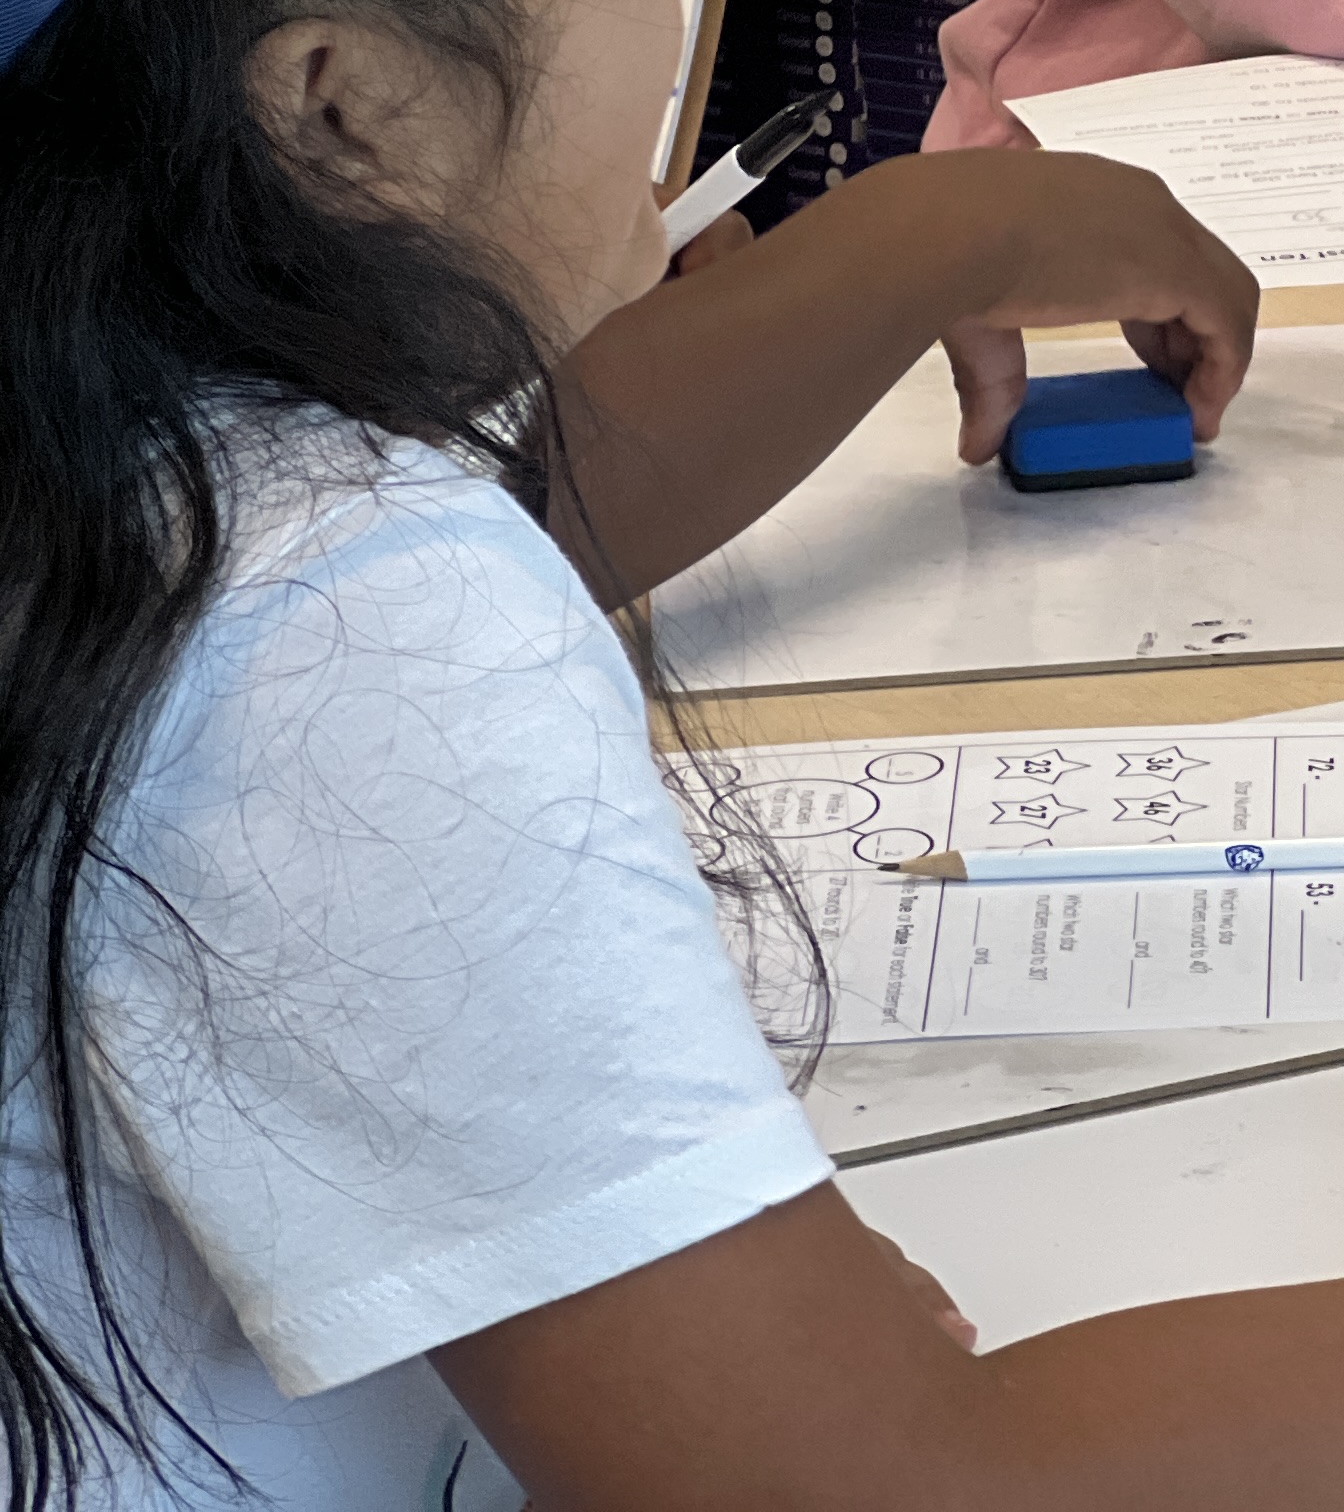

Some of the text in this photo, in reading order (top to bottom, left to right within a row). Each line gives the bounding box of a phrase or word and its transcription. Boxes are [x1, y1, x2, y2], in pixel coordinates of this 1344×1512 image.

[1260, 253, 1311, 262] Ten
[1023, 759, 1052, 775] 23
[1145, 757, 1174, 771] 36
[1019, 804, 1048, 820] 27
[1143, 800, 1172, 816] 46
[973, 947, 993, 965] and
[1133, 941, 1153, 959] and
